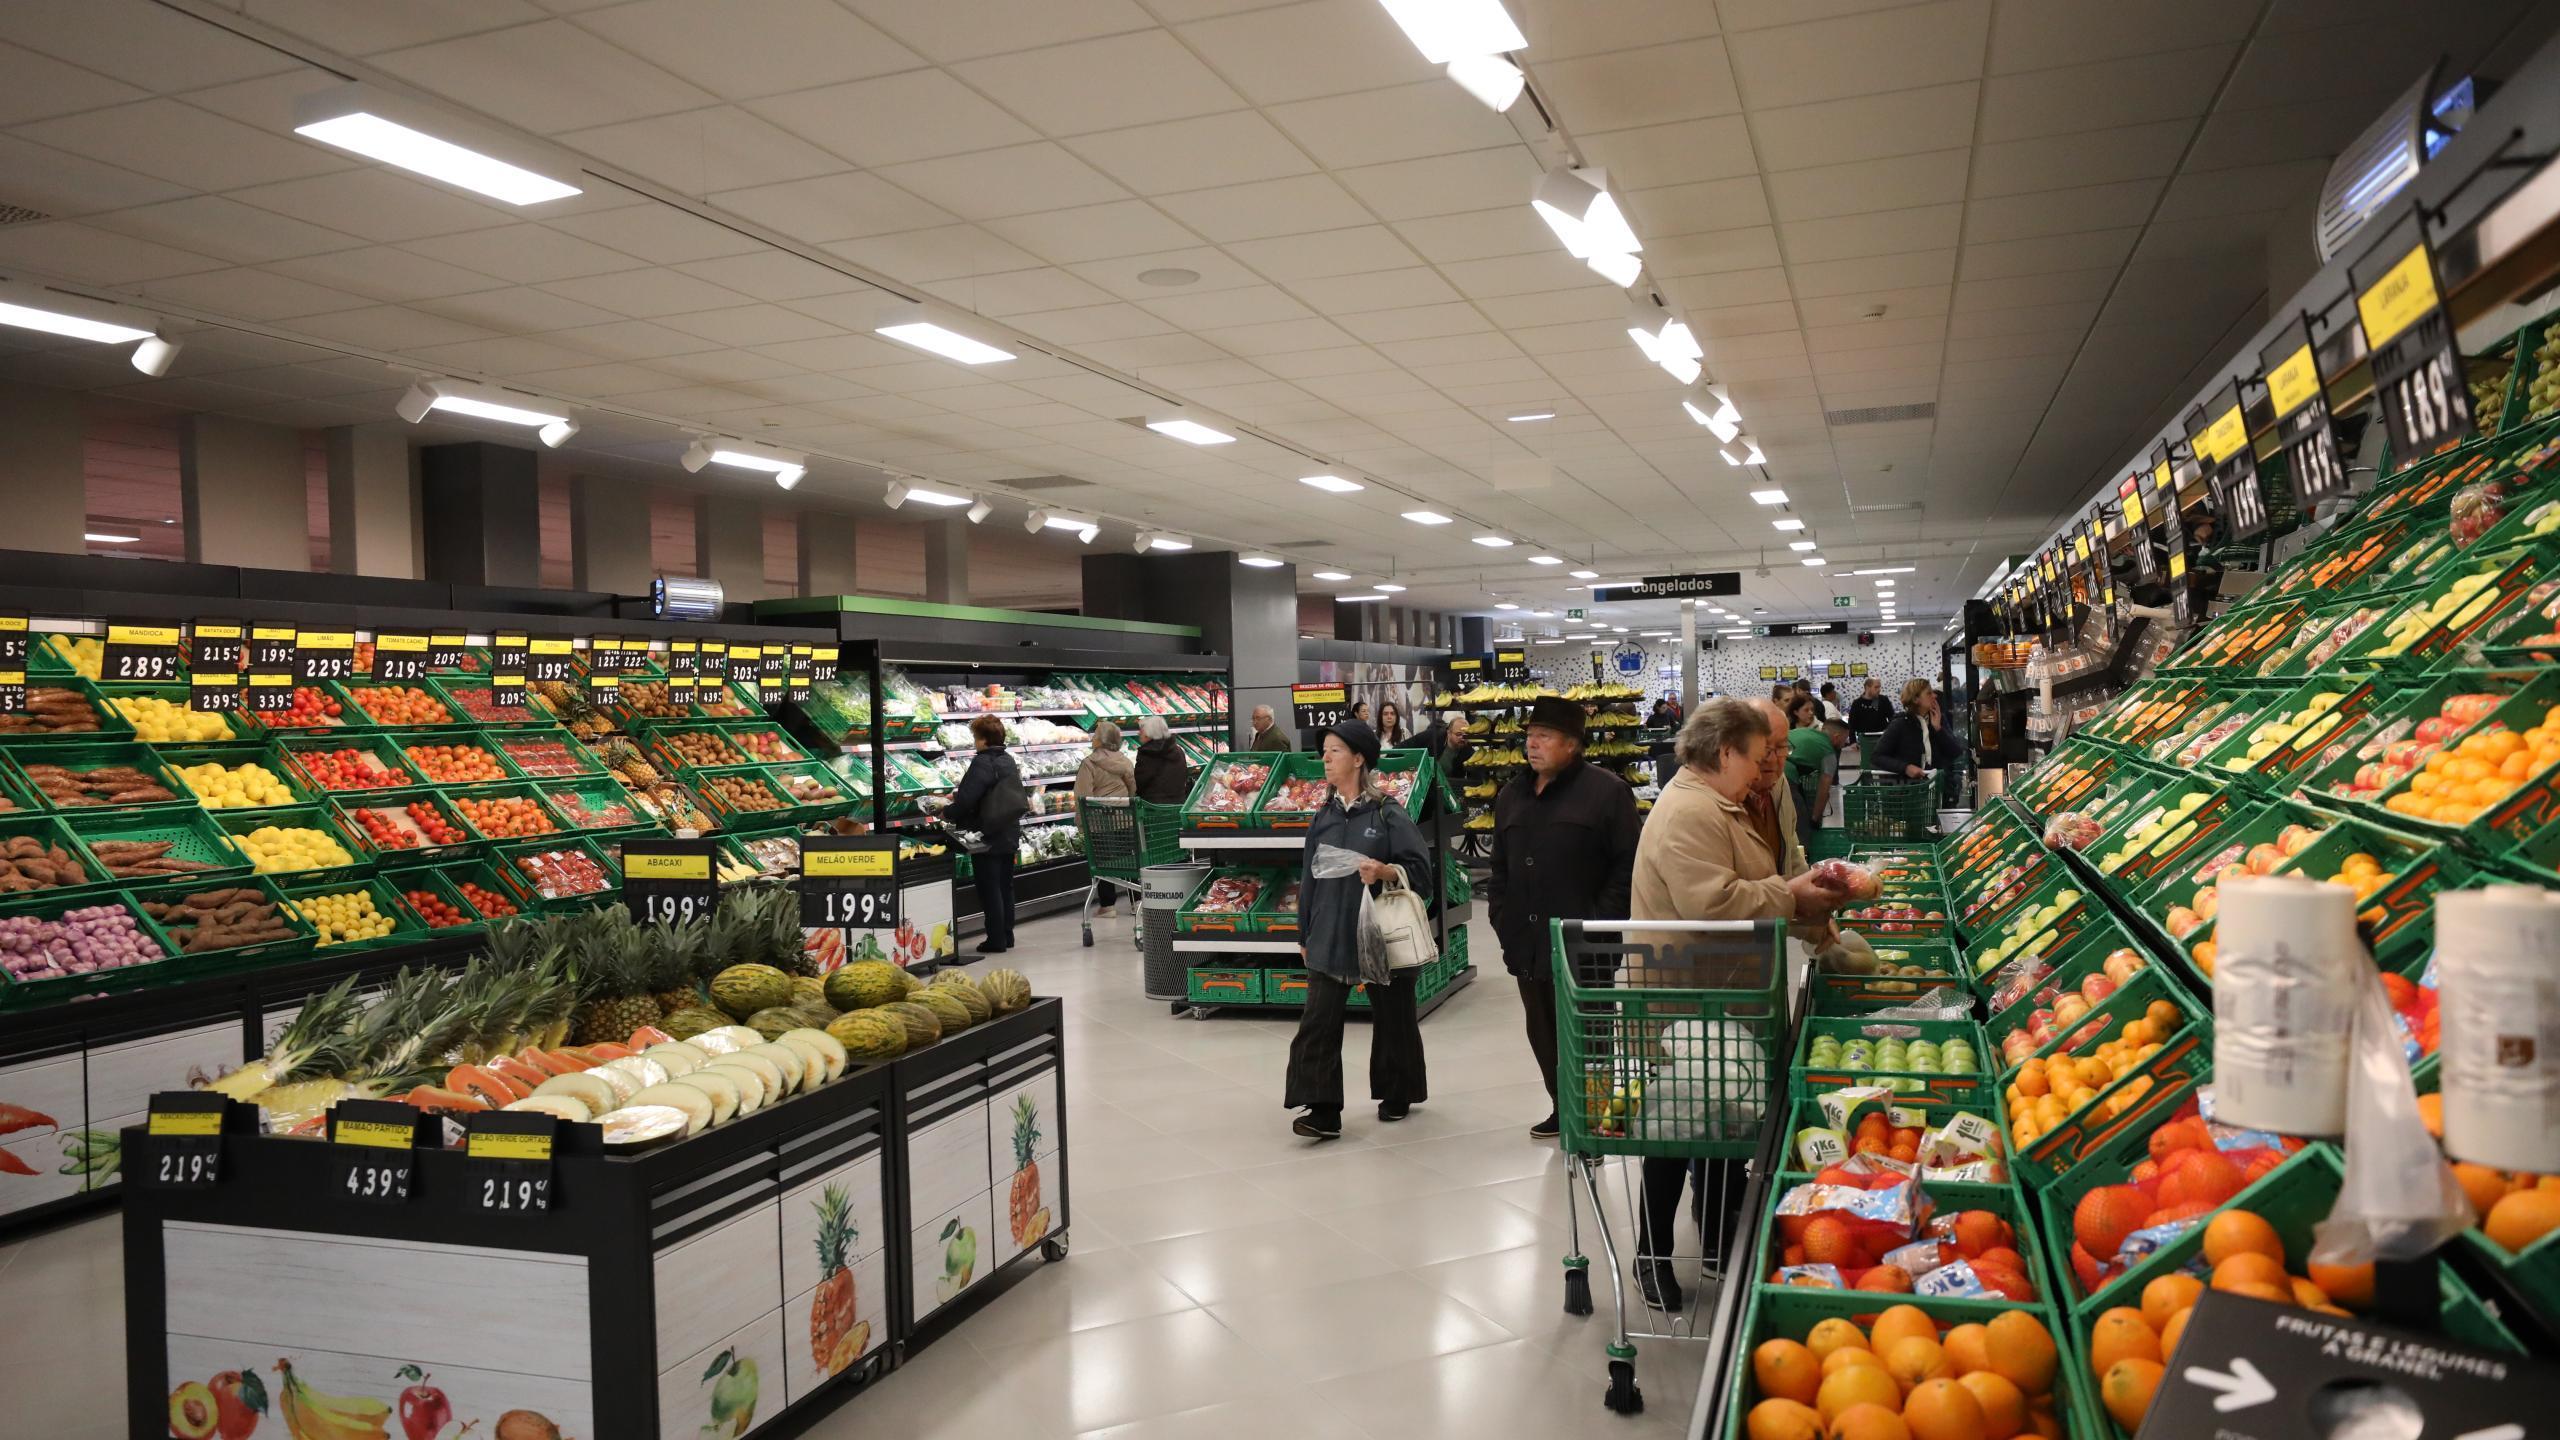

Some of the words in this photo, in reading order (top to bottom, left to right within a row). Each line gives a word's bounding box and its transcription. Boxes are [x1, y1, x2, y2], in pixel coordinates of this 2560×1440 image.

[1631, 577, 1713, 595] Congelados
[129, 629, 163, 637] MANDIOCA
[647, 858, 682, 867] ABACAXI
[816, 854, 846, 864] MELÃO
[847, 855, 876, 863] VERDE
[374, 1123, 409, 1135] PARTIDO
[2275, 1315, 2366, 1347] FRUTAS
[2369, 1336, 2387, 1350] E
[2390, 1340, 2508, 1382] LEGUMES
[2345, 1346, 2445, 1382] GRANEL
